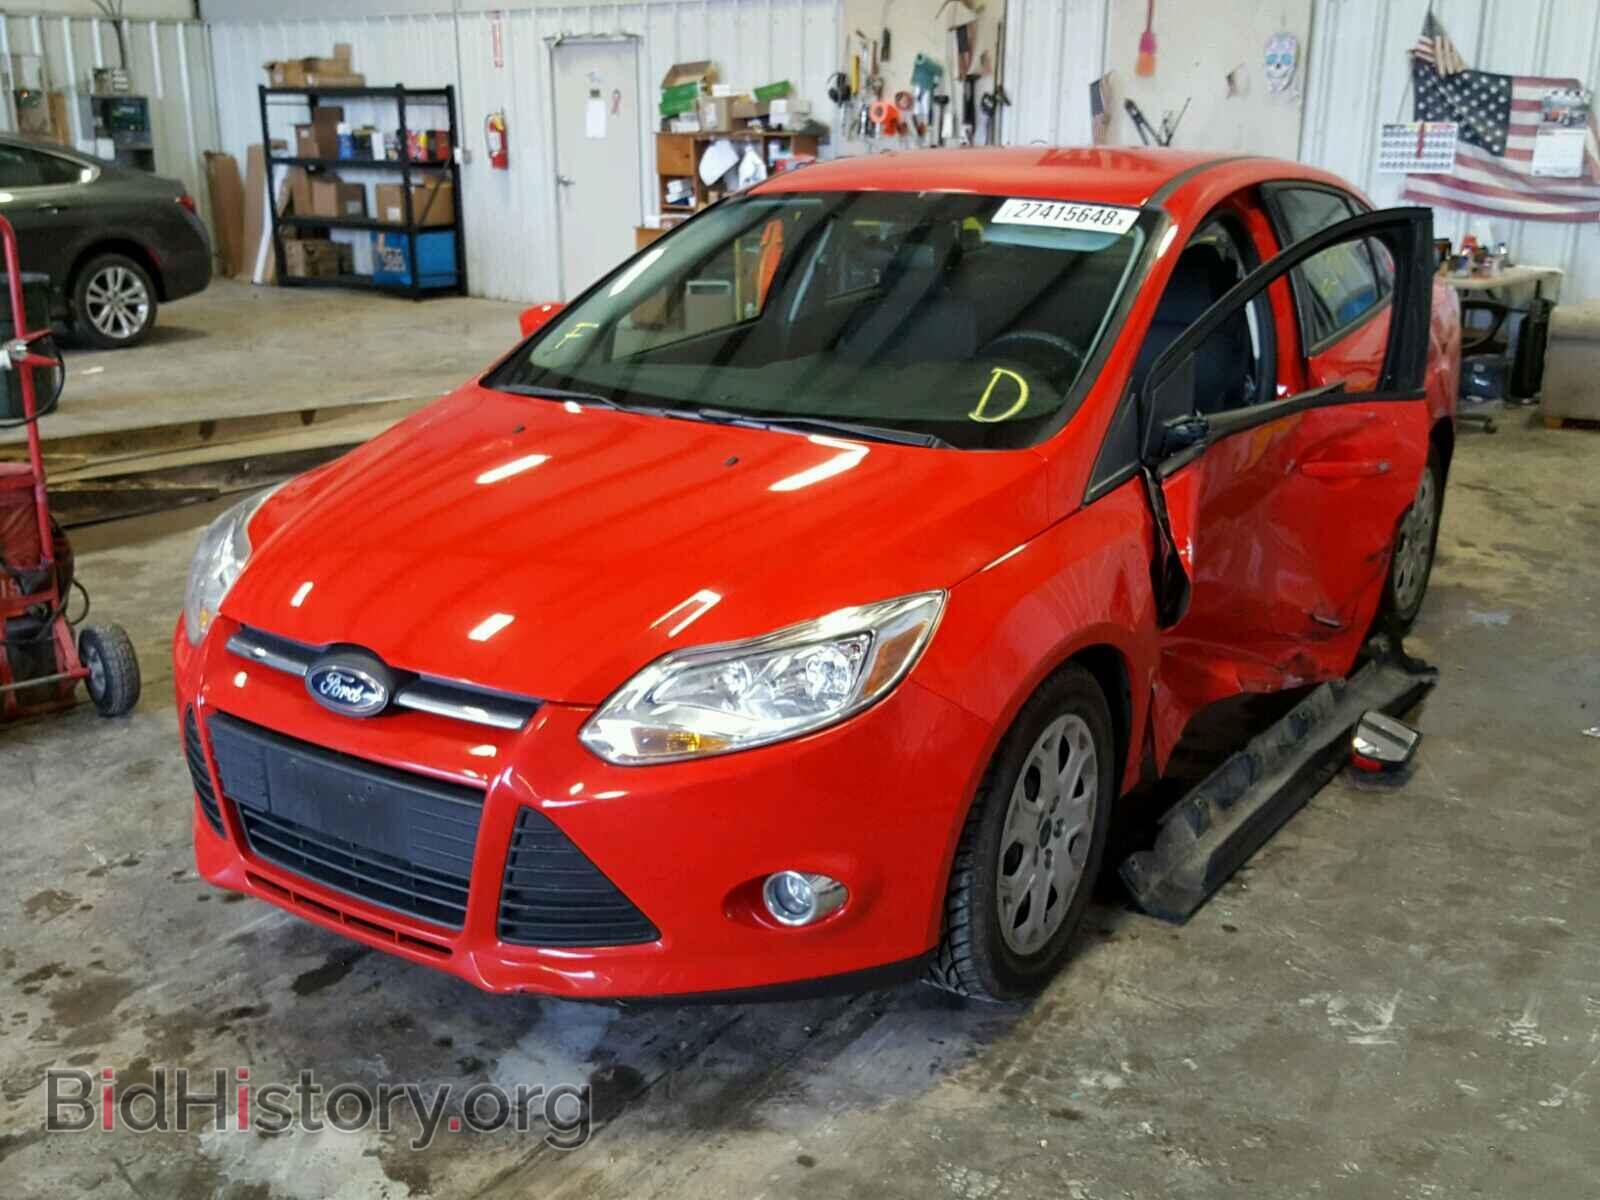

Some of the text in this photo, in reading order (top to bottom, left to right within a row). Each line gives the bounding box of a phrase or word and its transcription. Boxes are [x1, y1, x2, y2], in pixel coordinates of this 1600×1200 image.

[1013, 202, 1119, 226] 27415648
[968, 367, 1029, 423] D
[320, 671, 365, 703] Ford
